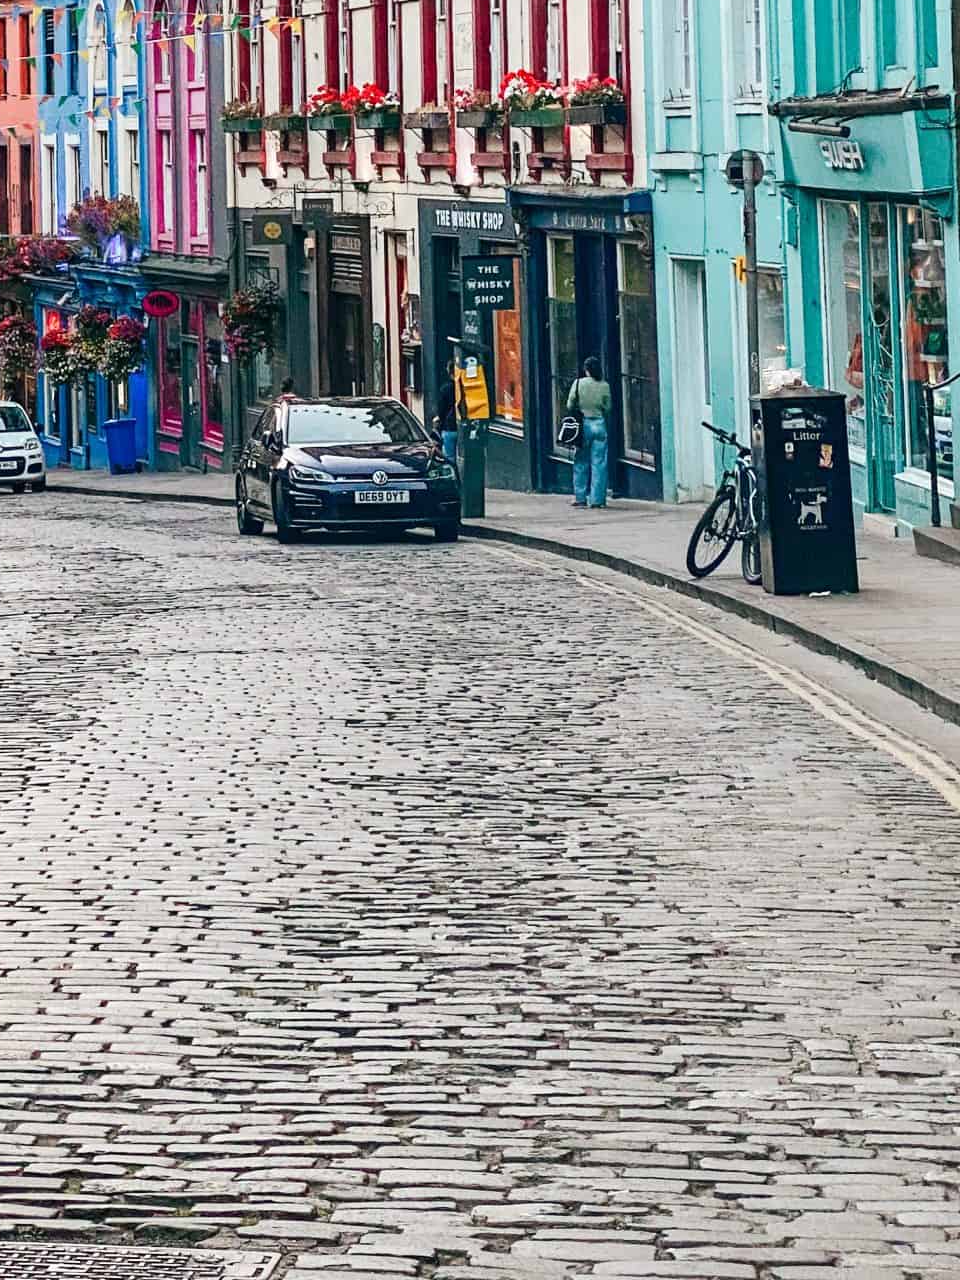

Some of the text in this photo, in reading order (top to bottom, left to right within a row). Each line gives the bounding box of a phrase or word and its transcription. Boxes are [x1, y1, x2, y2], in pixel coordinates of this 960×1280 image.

[436, 209, 504, 230] THE WHISKY SHOP
[477, 266, 500, 274] THE
[467, 280, 512, 288] WHISKY
[474, 295, 504, 305] SHOP
[793, 431, 821, 441] Litter
[360, 491, 384, 502] DE69
